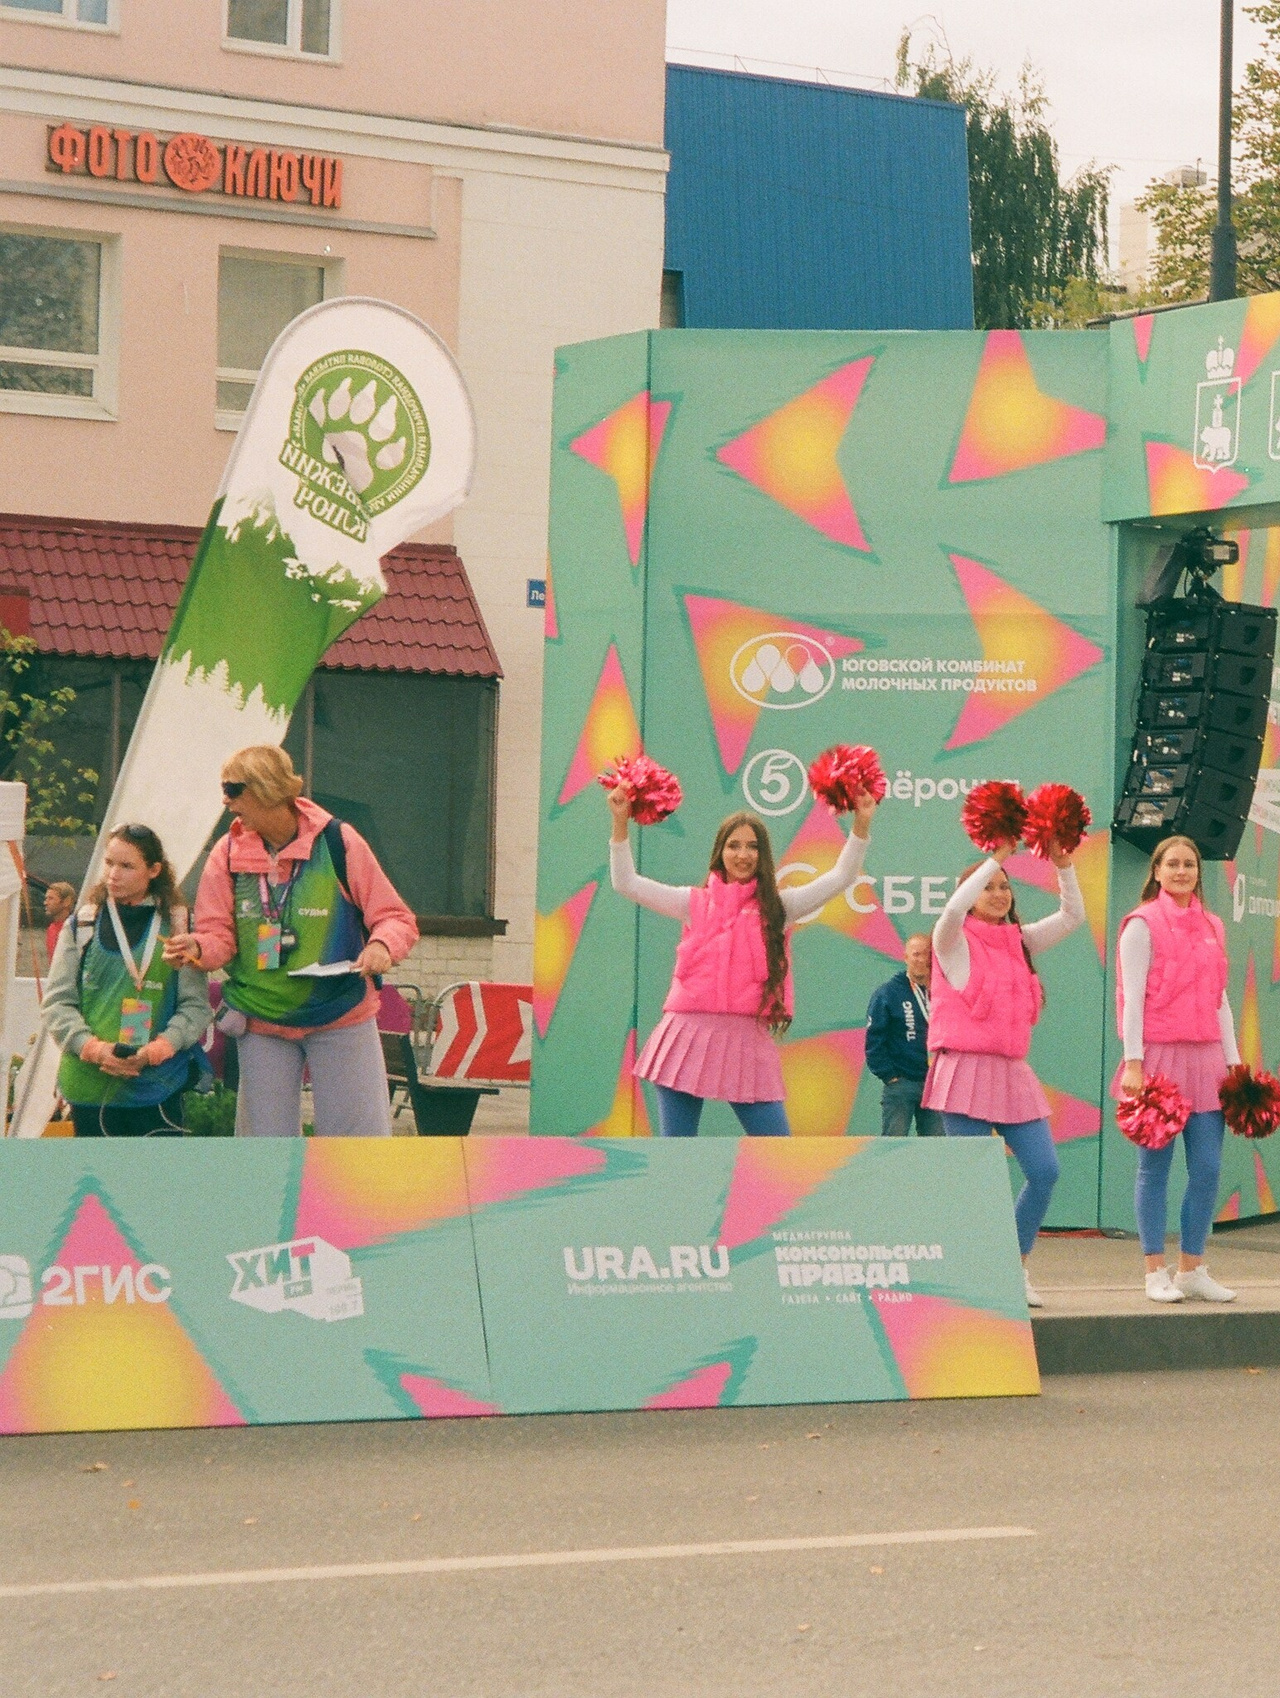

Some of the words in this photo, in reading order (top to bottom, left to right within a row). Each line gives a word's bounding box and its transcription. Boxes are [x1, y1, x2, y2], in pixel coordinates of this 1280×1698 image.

[50, 122, 158, 184] ФОТО
[224, 145, 344, 209] КЛЮЧИ
[842, 657, 933, 672] ЮГОВСКОЙ
[936, 659, 1026, 673] КОМБИНАТ
[842, 678, 937, 690] МОЛОЧНЫХ
[941, 678, 1037, 693] ПРОДУКТОВ
[845, 875, 959, 915] СБЕ
[902, 1000, 917, 1042] TIMING
[772, 1230, 851, 1241] МЕДИАГРУППА
[235, 1242, 316, 1291] ХИТ
[563, 1245, 730, 1281] URA.RU
[775, 1244, 944, 1262] КОМСОМОЛЬСКАЯ
[42, 1262, 171, 1305] 2ГИС
[777, 1262, 911, 1288] ПРАВДА
[782, 1293, 820, 1304] ГАЗЕТА
[878, 1292, 913, 1303] РАДИО
